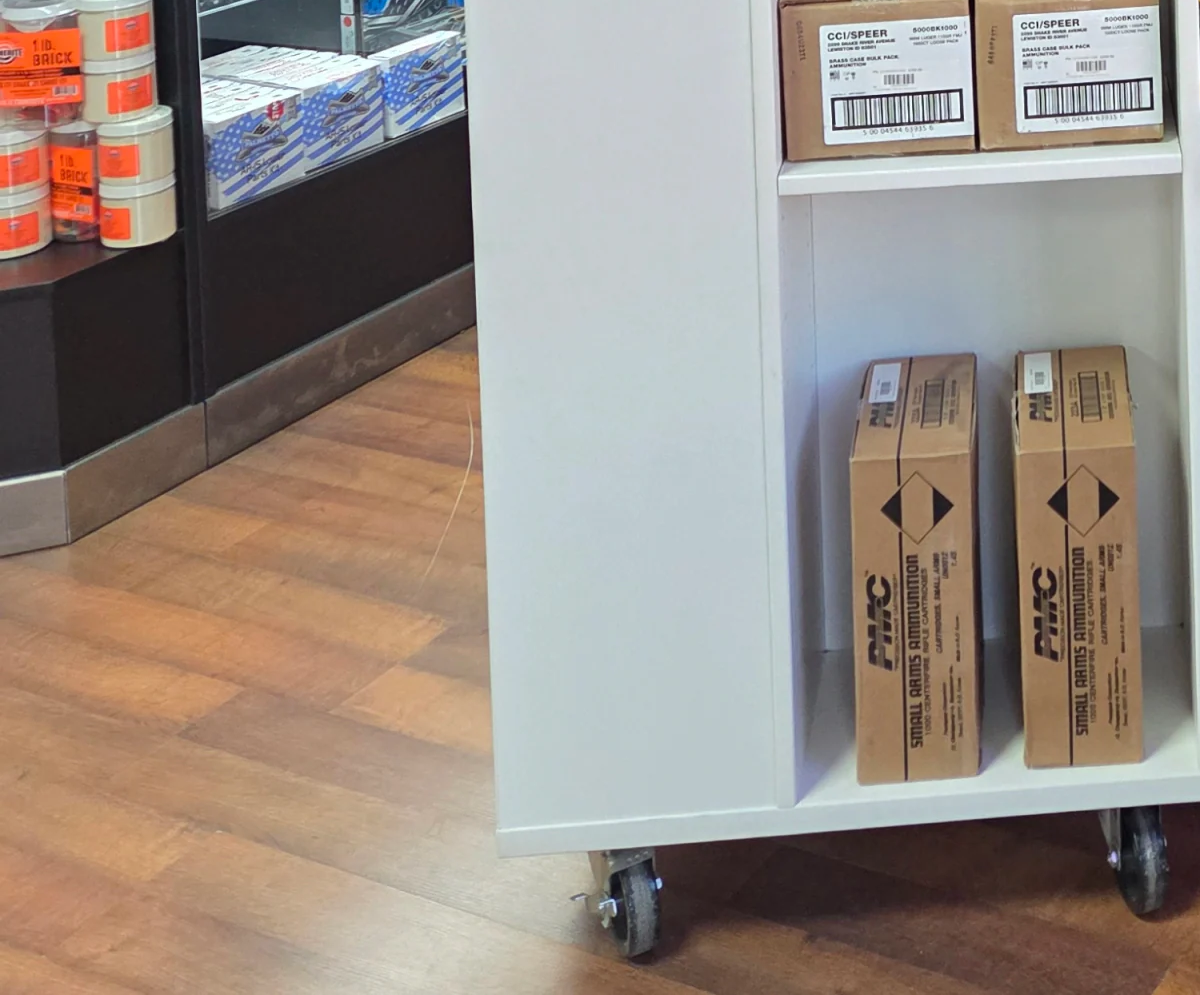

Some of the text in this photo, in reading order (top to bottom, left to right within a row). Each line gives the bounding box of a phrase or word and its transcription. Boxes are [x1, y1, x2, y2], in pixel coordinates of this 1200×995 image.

[913, 24, 958, 33] 5000BK1000
[1021, 19, 1079, 30] CCI/SPEER
[1105, 14, 1148, 22] 5000BK1000
[827, 29, 888, 40] CCI/SPEER
[33, 52, 73, 66] BRICK
[60, 165, 88, 183] BRICK
[920, 568, 929, 625] CARTRIDGES
[865, 574, 892, 671] PMC
[1032, 565, 1059, 662] PMC
[921, 628, 929, 653] RIFLE
[1072, 547, 1088, 735] SMALL ARMS AMMUNITION
[1087, 620, 1095, 644] RIFLE
[906, 555, 923, 748] SMALL ARMS AMMUNITION
[923, 657, 931, 712] CENTERFIRE
[1088, 648, 1096, 701] CENTERFIRE
